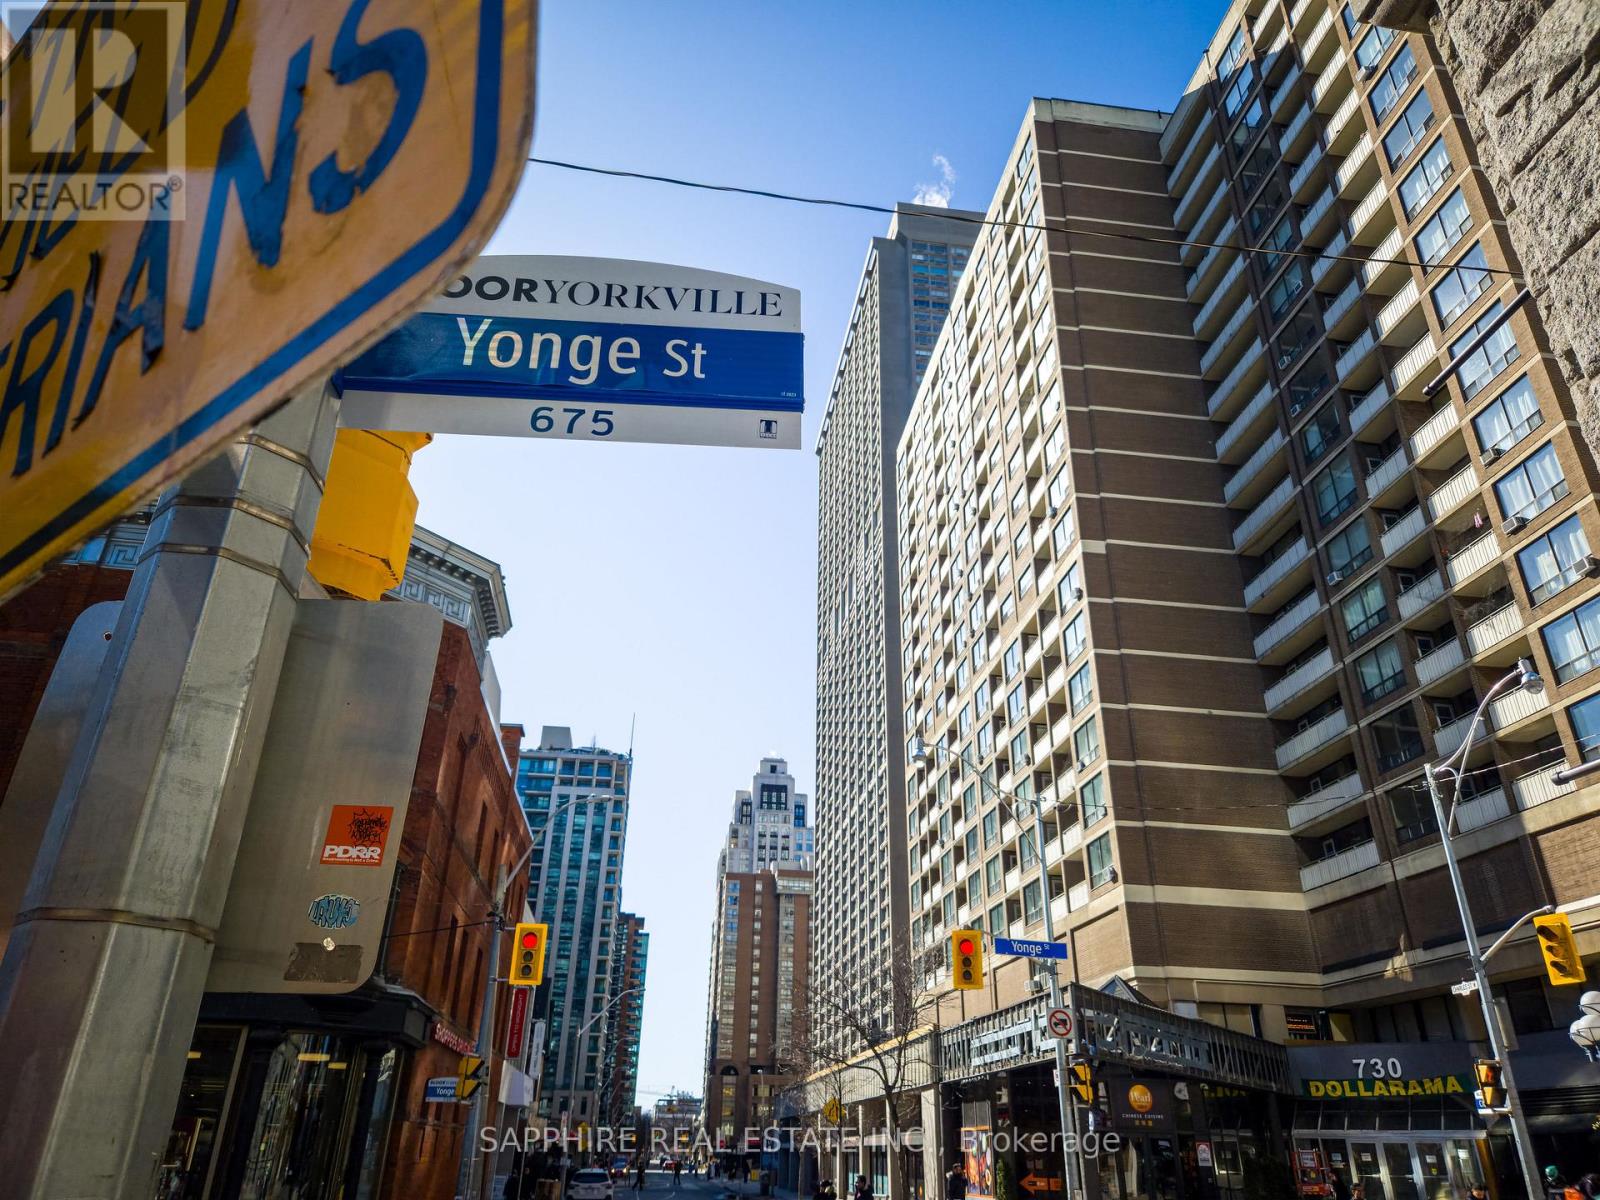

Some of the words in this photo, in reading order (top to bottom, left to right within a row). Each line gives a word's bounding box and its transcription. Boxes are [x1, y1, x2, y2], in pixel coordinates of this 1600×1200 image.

[441, 275, 782, 317] OORYORKVILLE
[456, 317, 641, 385] Yonge
[662, 337, 707, 379] St
[530, 406, 615, 437] 675
[1011, 940, 1042, 956] Yonge
[1352, 1057, 1402, 1079] 730
[436, 1087, 455, 1097] Yonge
[1309, 1076, 1463, 1097] DOLLARAMA
